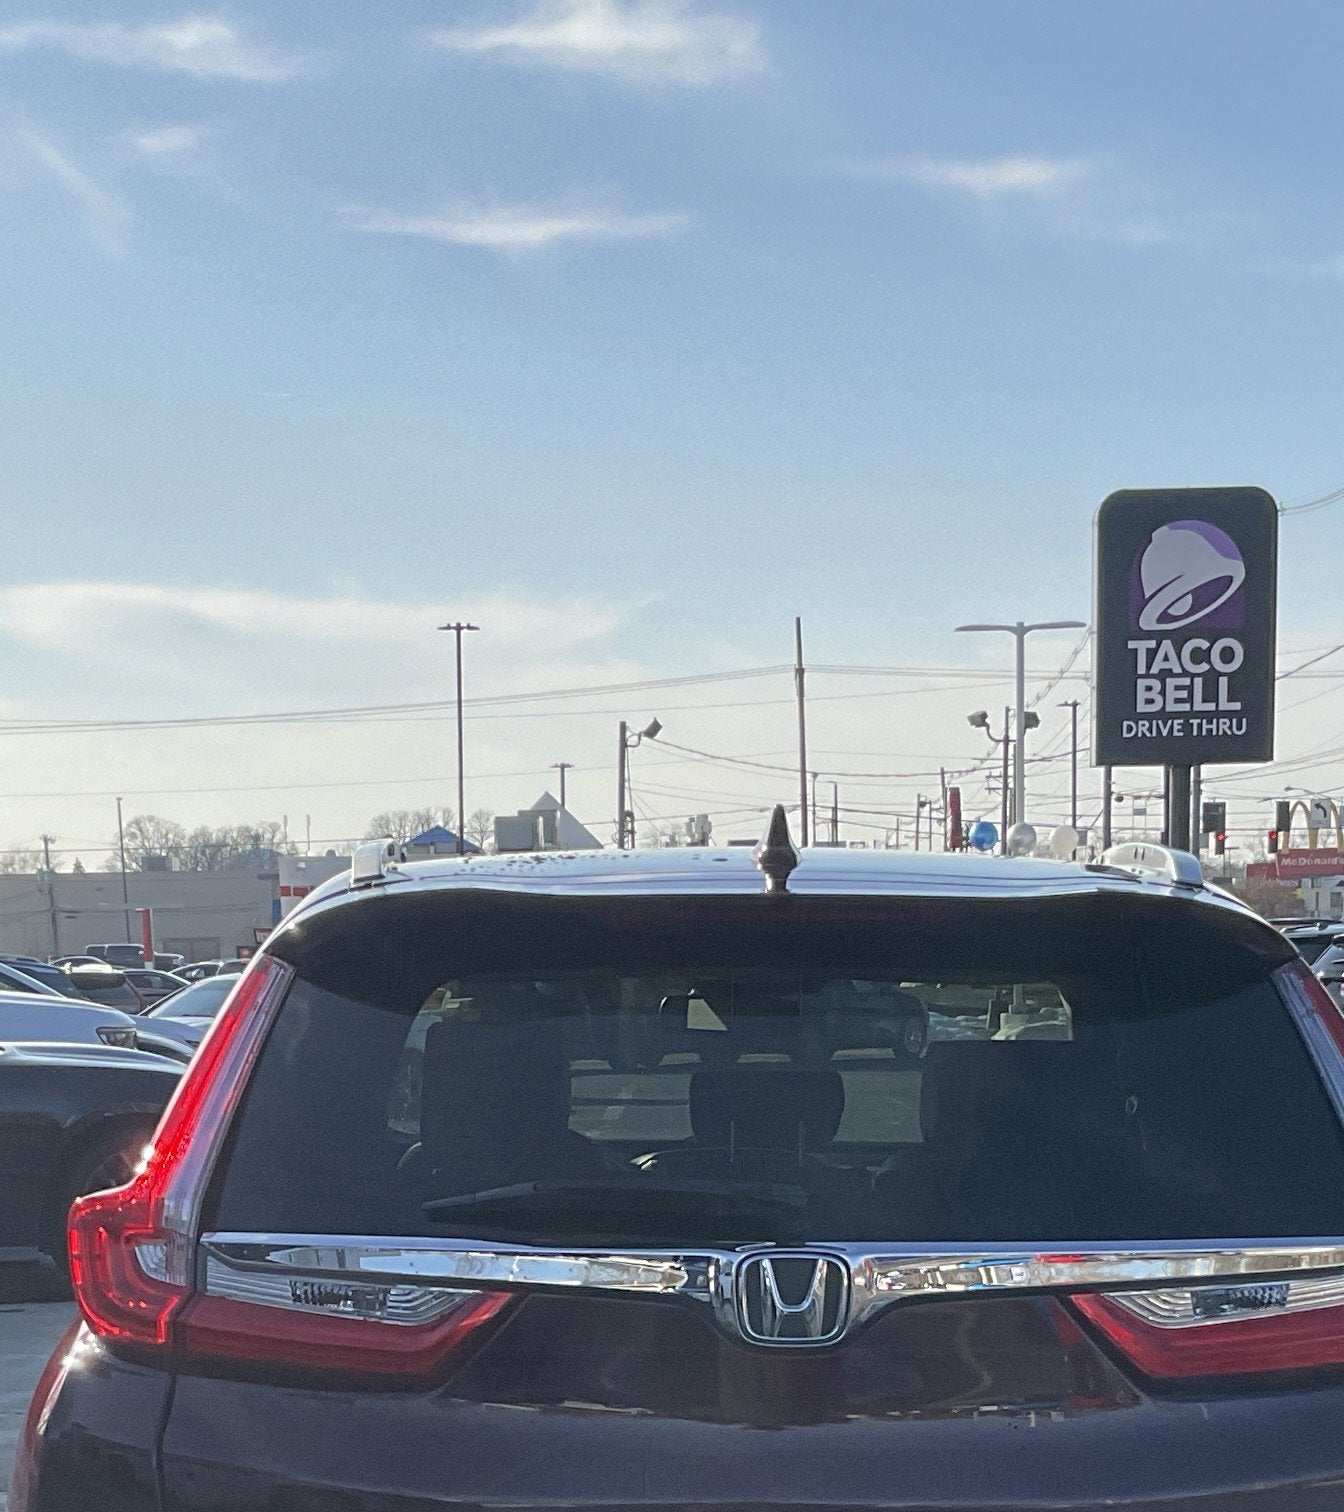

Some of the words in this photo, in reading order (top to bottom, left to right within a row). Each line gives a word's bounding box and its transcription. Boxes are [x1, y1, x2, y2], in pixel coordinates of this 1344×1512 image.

[1127, 637, 1244, 674] TACO
[1136, 676, 1242, 713] BELL
[1122, 719, 1184, 738] DRIVE
[1189, 717, 1247, 736] THRU
